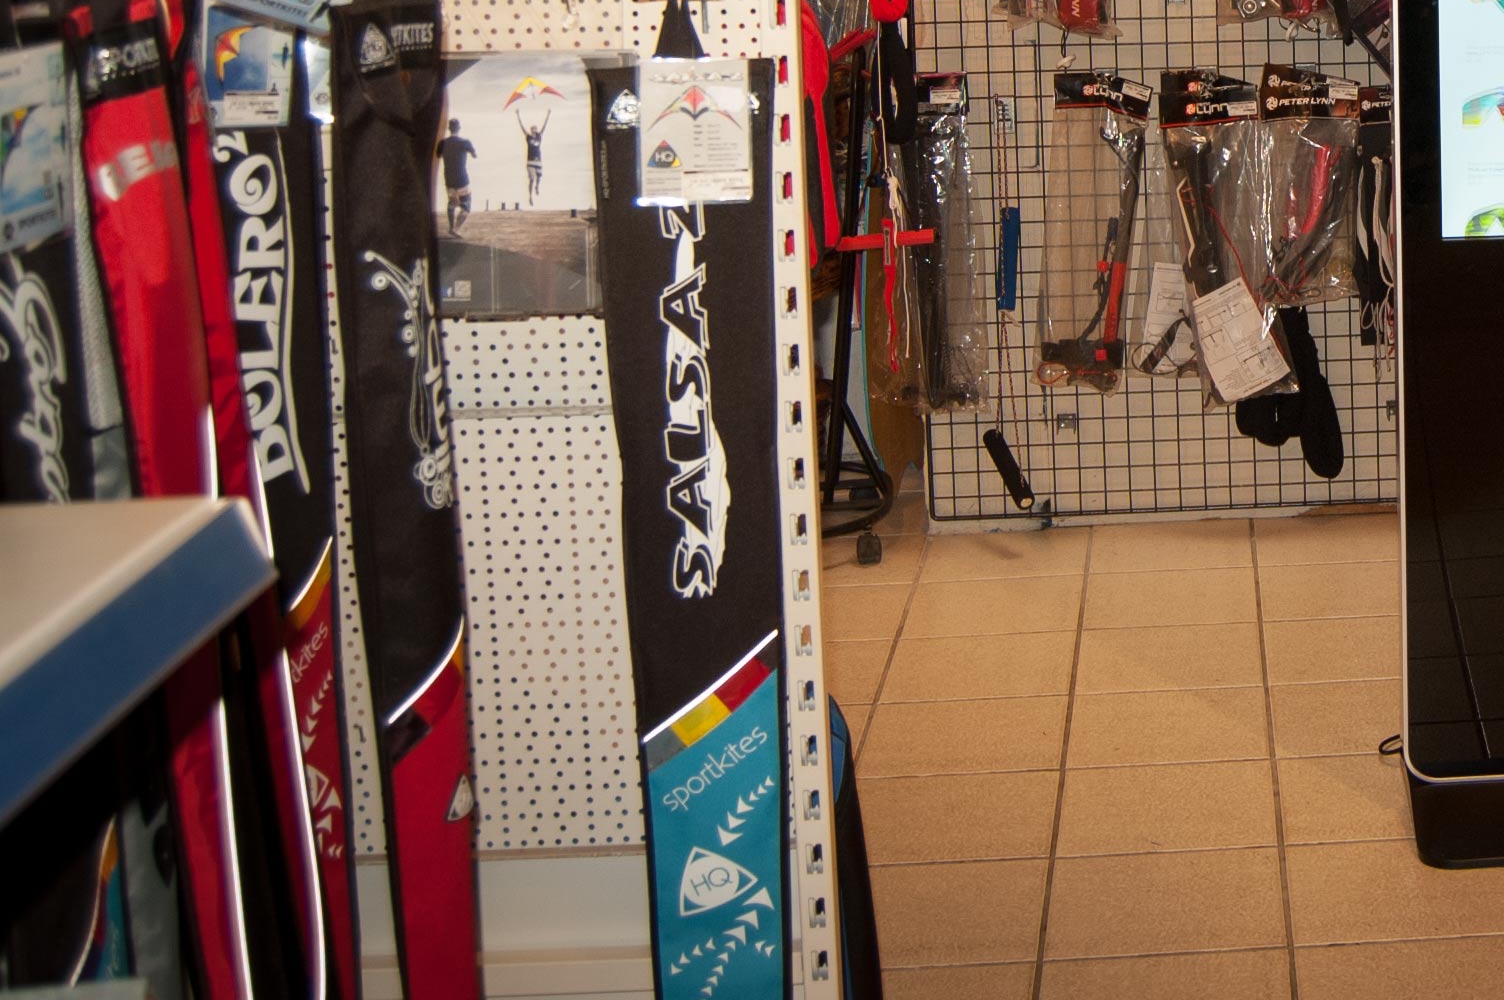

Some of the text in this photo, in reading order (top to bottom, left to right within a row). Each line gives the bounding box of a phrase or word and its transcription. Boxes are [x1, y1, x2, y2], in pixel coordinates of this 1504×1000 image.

[1278, 96, 1336, 107] PETER LYNN
[655, 151, 673, 163] HQ
[659, 261, 713, 599] SALSA
[291, 621, 329, 684] kites
[663, 725, 769, 812] sportkites
[690, 866, 732, 898] HQ
